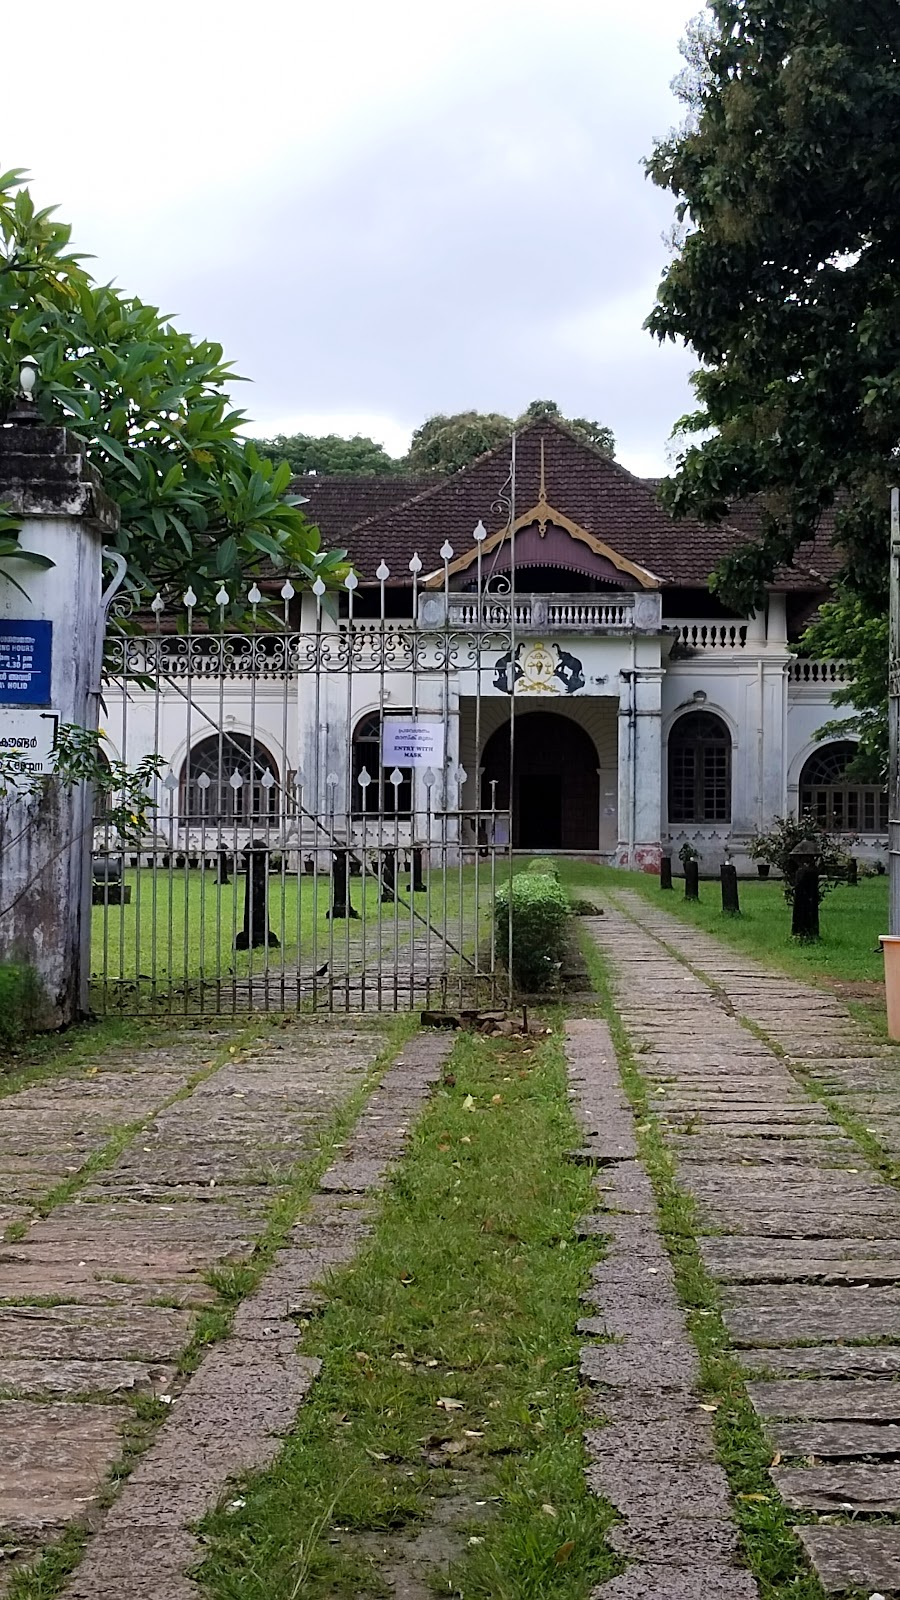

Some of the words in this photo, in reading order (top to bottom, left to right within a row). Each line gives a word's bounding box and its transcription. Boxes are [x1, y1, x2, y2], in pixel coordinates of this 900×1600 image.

[11, 644, 34, 652] HOURS
[6, 661, 21, 669] 4.30
[7, 682, 28, 690] HOLID
